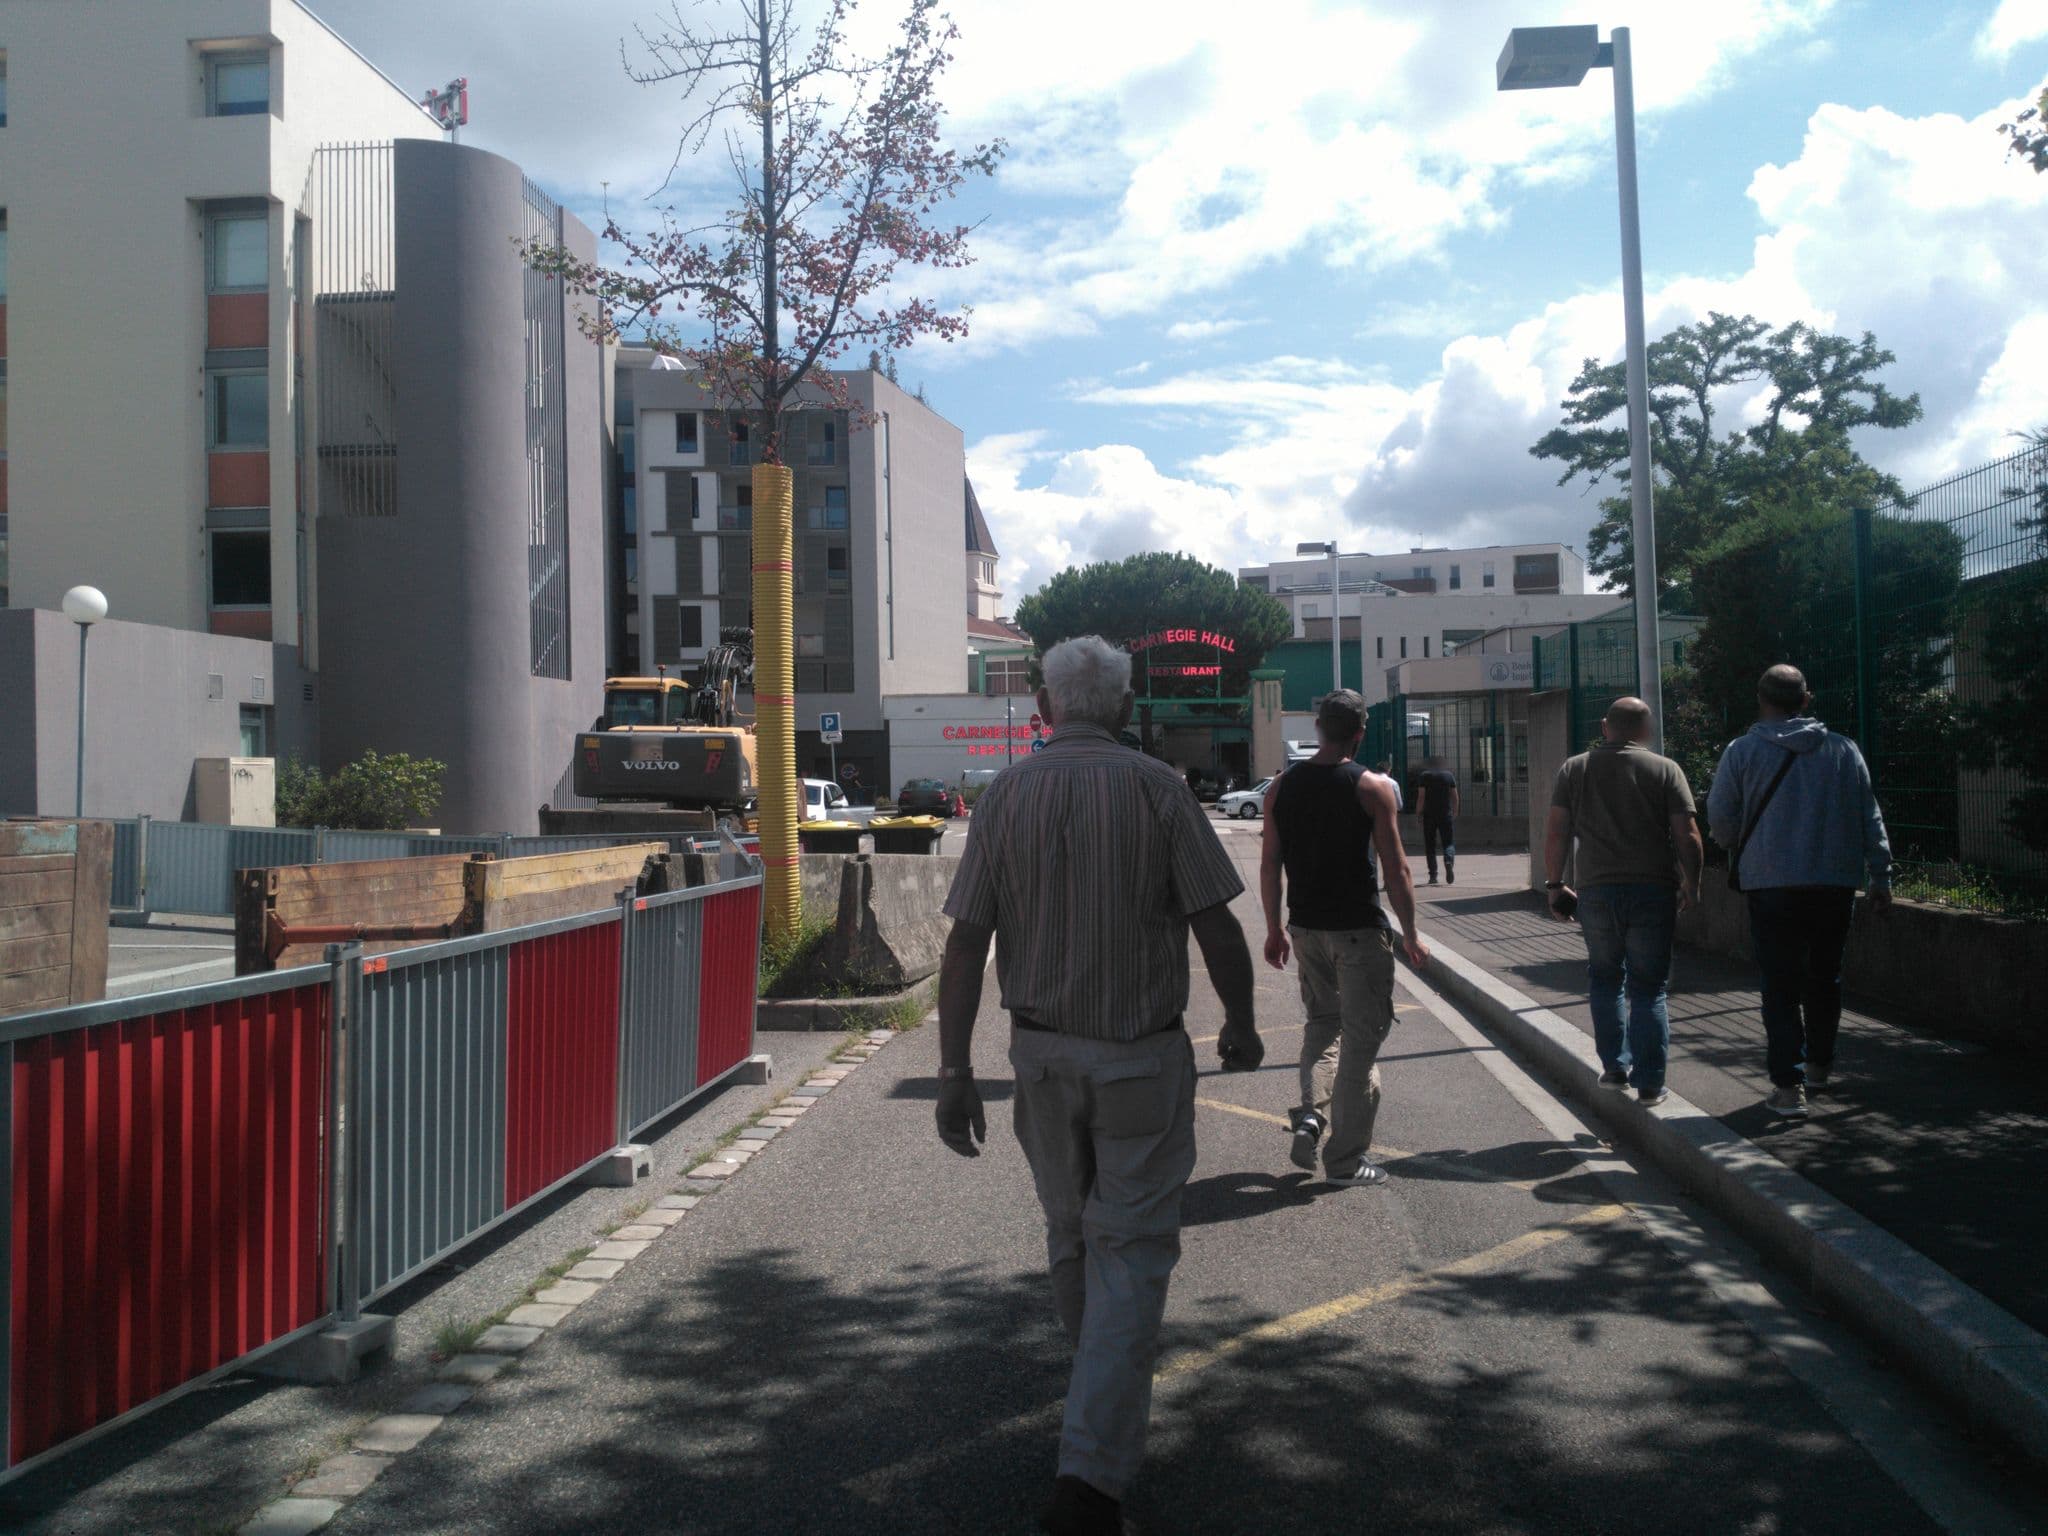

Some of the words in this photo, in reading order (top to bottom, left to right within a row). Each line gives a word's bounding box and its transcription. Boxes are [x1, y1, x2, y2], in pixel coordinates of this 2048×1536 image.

[1130, 629, 1198, 653] CARNEGIE
[1201, 630, 1235, 653] HALL
[1147, 666, 1222, 676] RESTAURANT
[825, 717, 834, 729] P
[943, 726, 1033, 740] CARNEGIE
[621, 760, 681, 771] VOLVO
